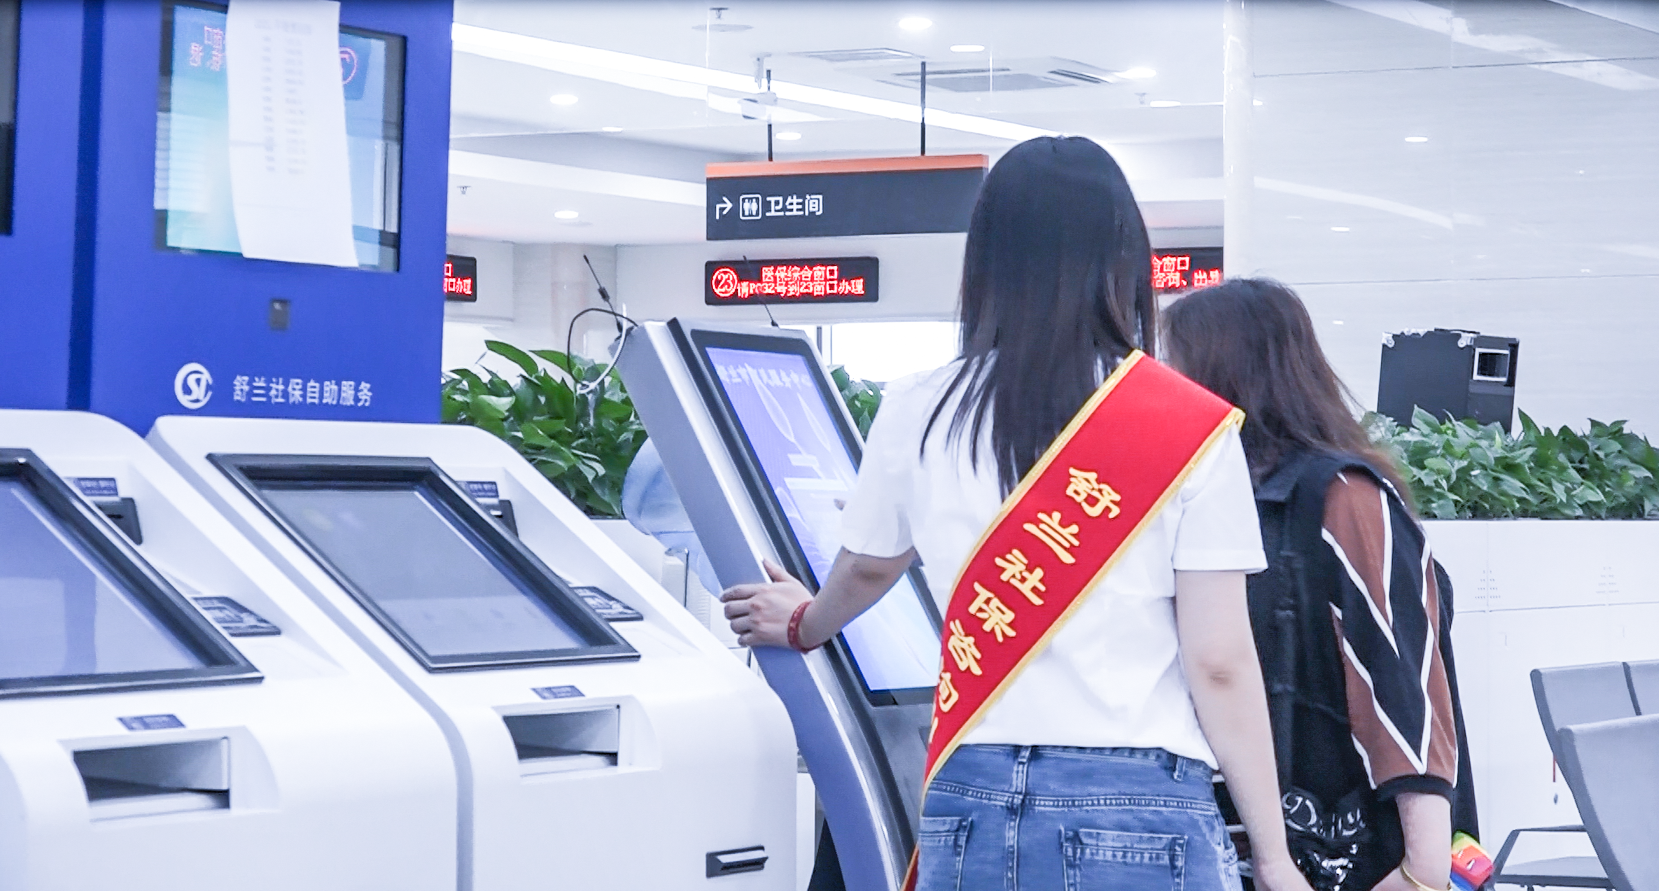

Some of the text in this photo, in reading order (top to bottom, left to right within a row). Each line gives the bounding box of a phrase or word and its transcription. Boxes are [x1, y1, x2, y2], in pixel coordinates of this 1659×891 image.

[765, 194, 824, 217] 卫生间
[714, 269, 736, 295] 23
[761, 265, 838, 282] 医保综合窗口
[232, 374, 374, 407] 舒兰社保自助服务
[928, 466, 1122, 743] 舒兰社保咨询
